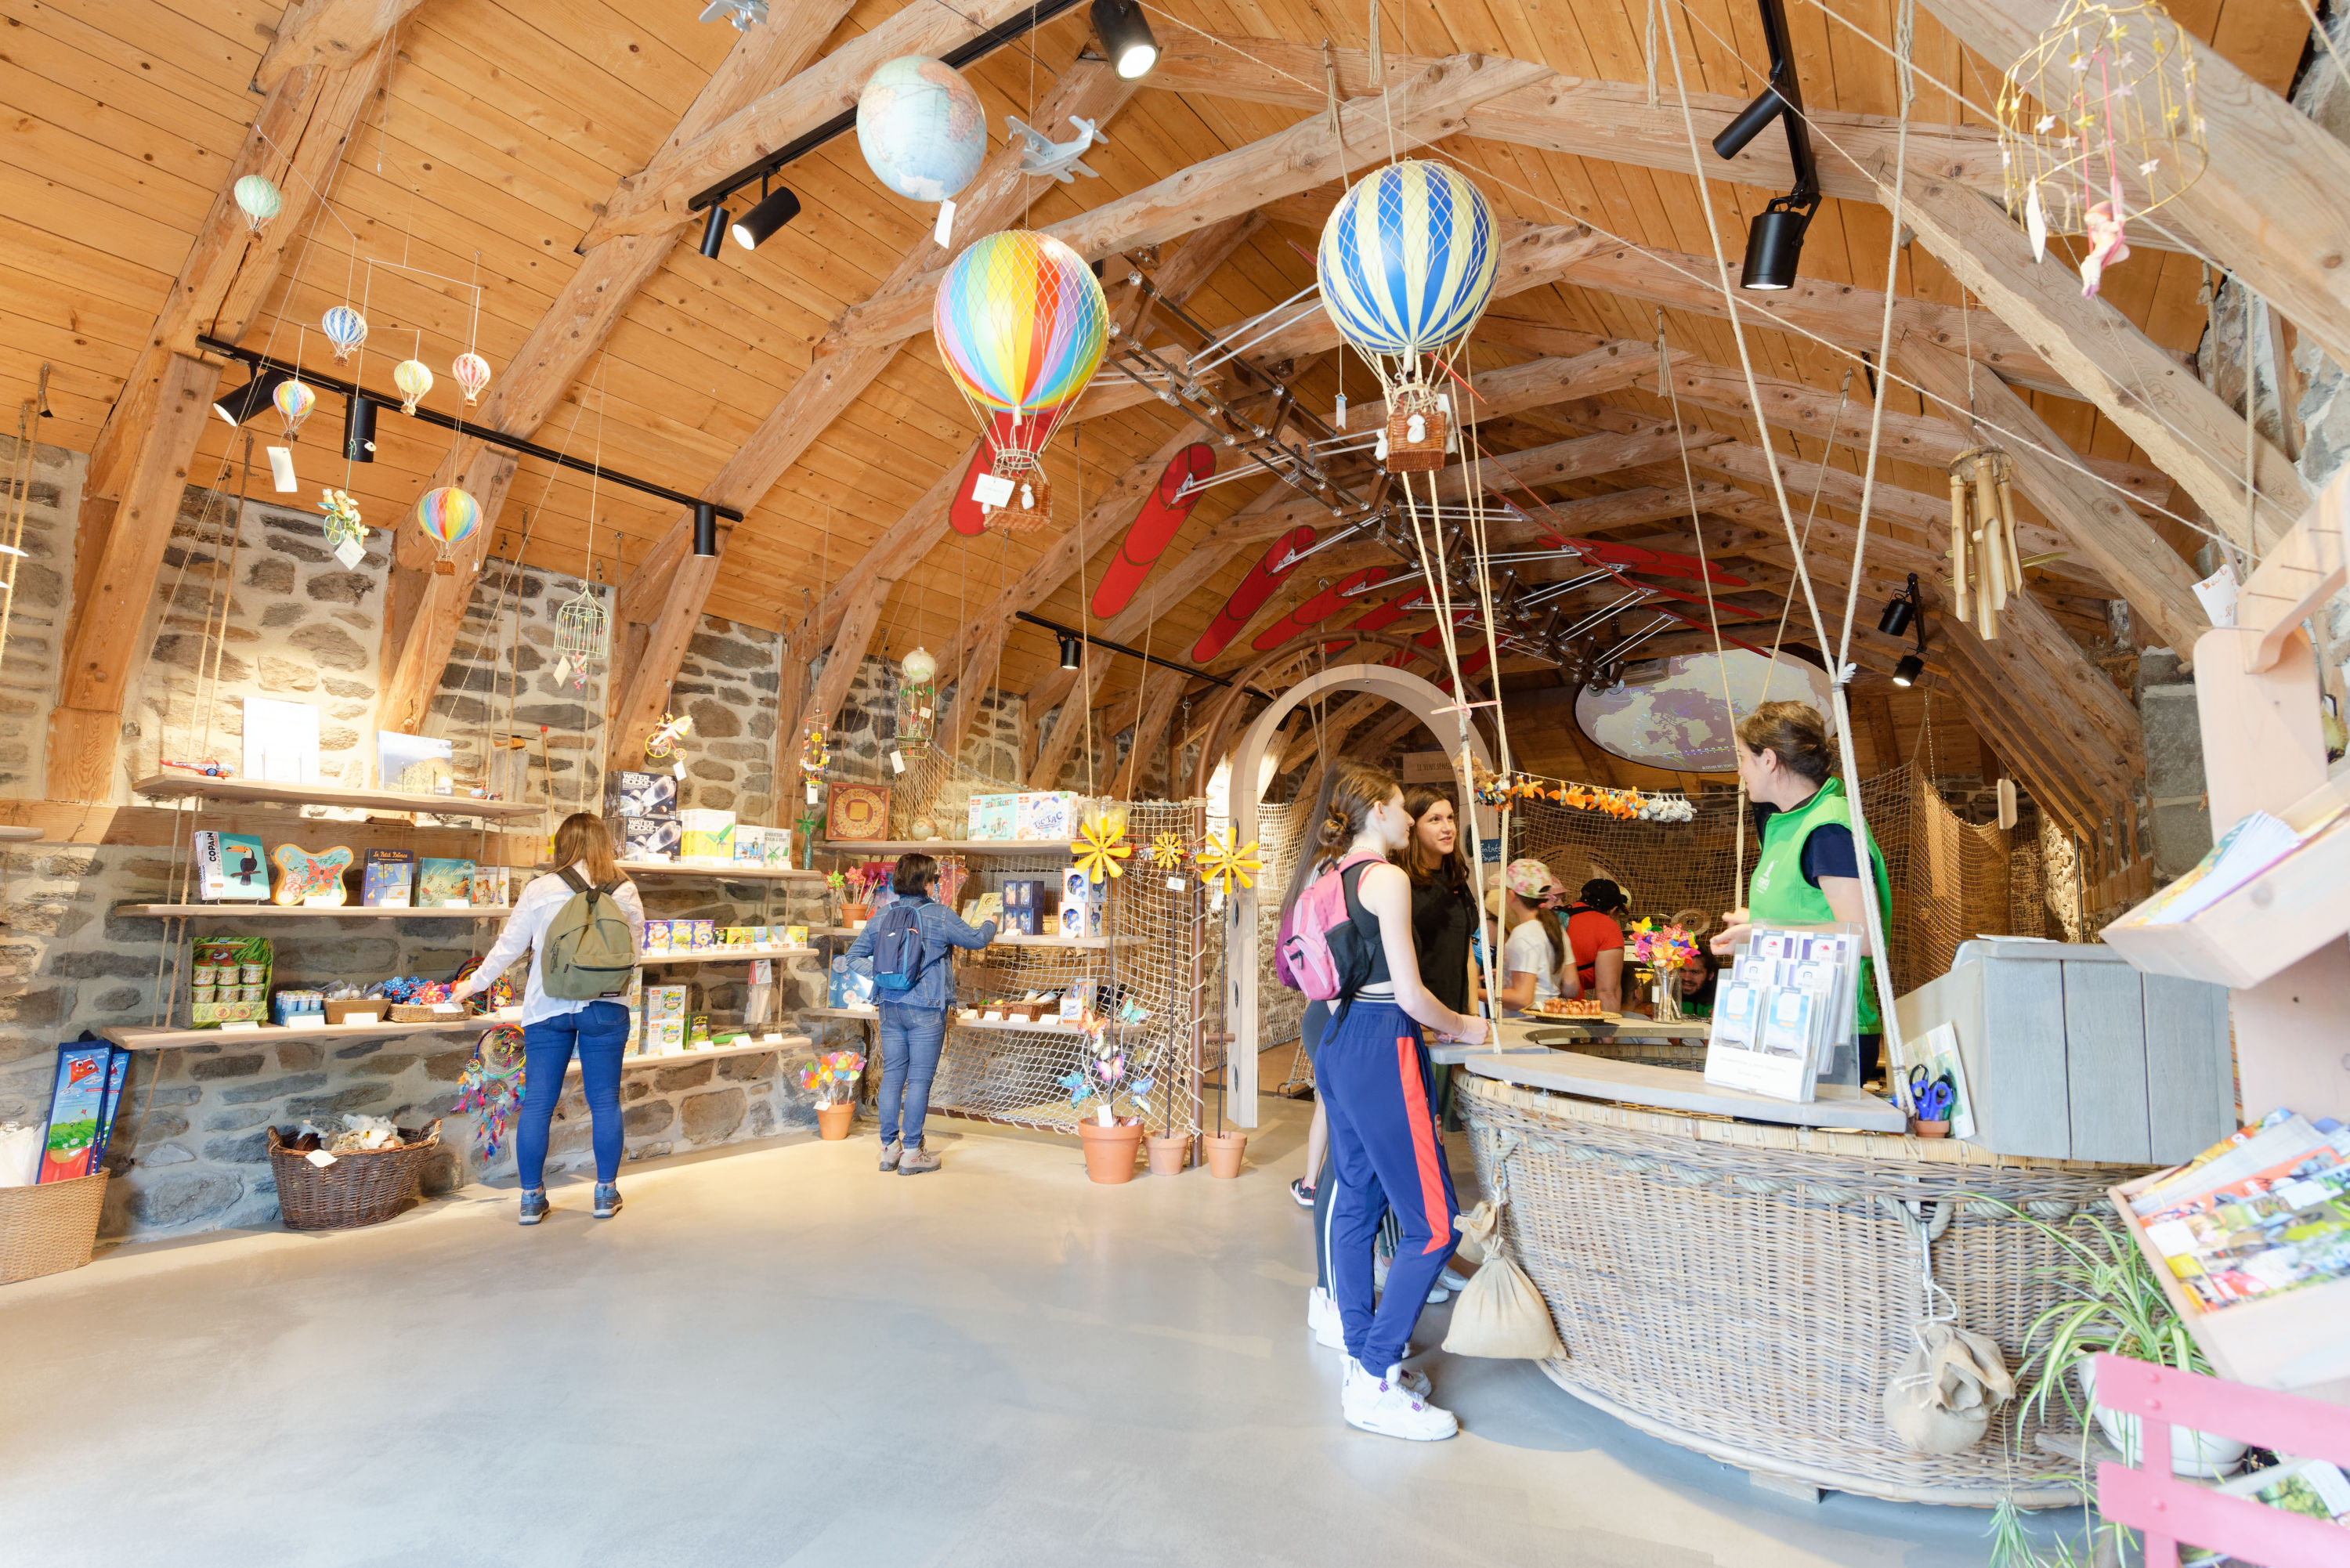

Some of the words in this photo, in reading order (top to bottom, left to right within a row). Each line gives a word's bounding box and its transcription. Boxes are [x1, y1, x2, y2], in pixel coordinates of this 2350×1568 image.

[623, 772, 650, 782] WATER
[1047, 811, 1063, 823] TAC
[627, 824, 660, 833] ROCKET
